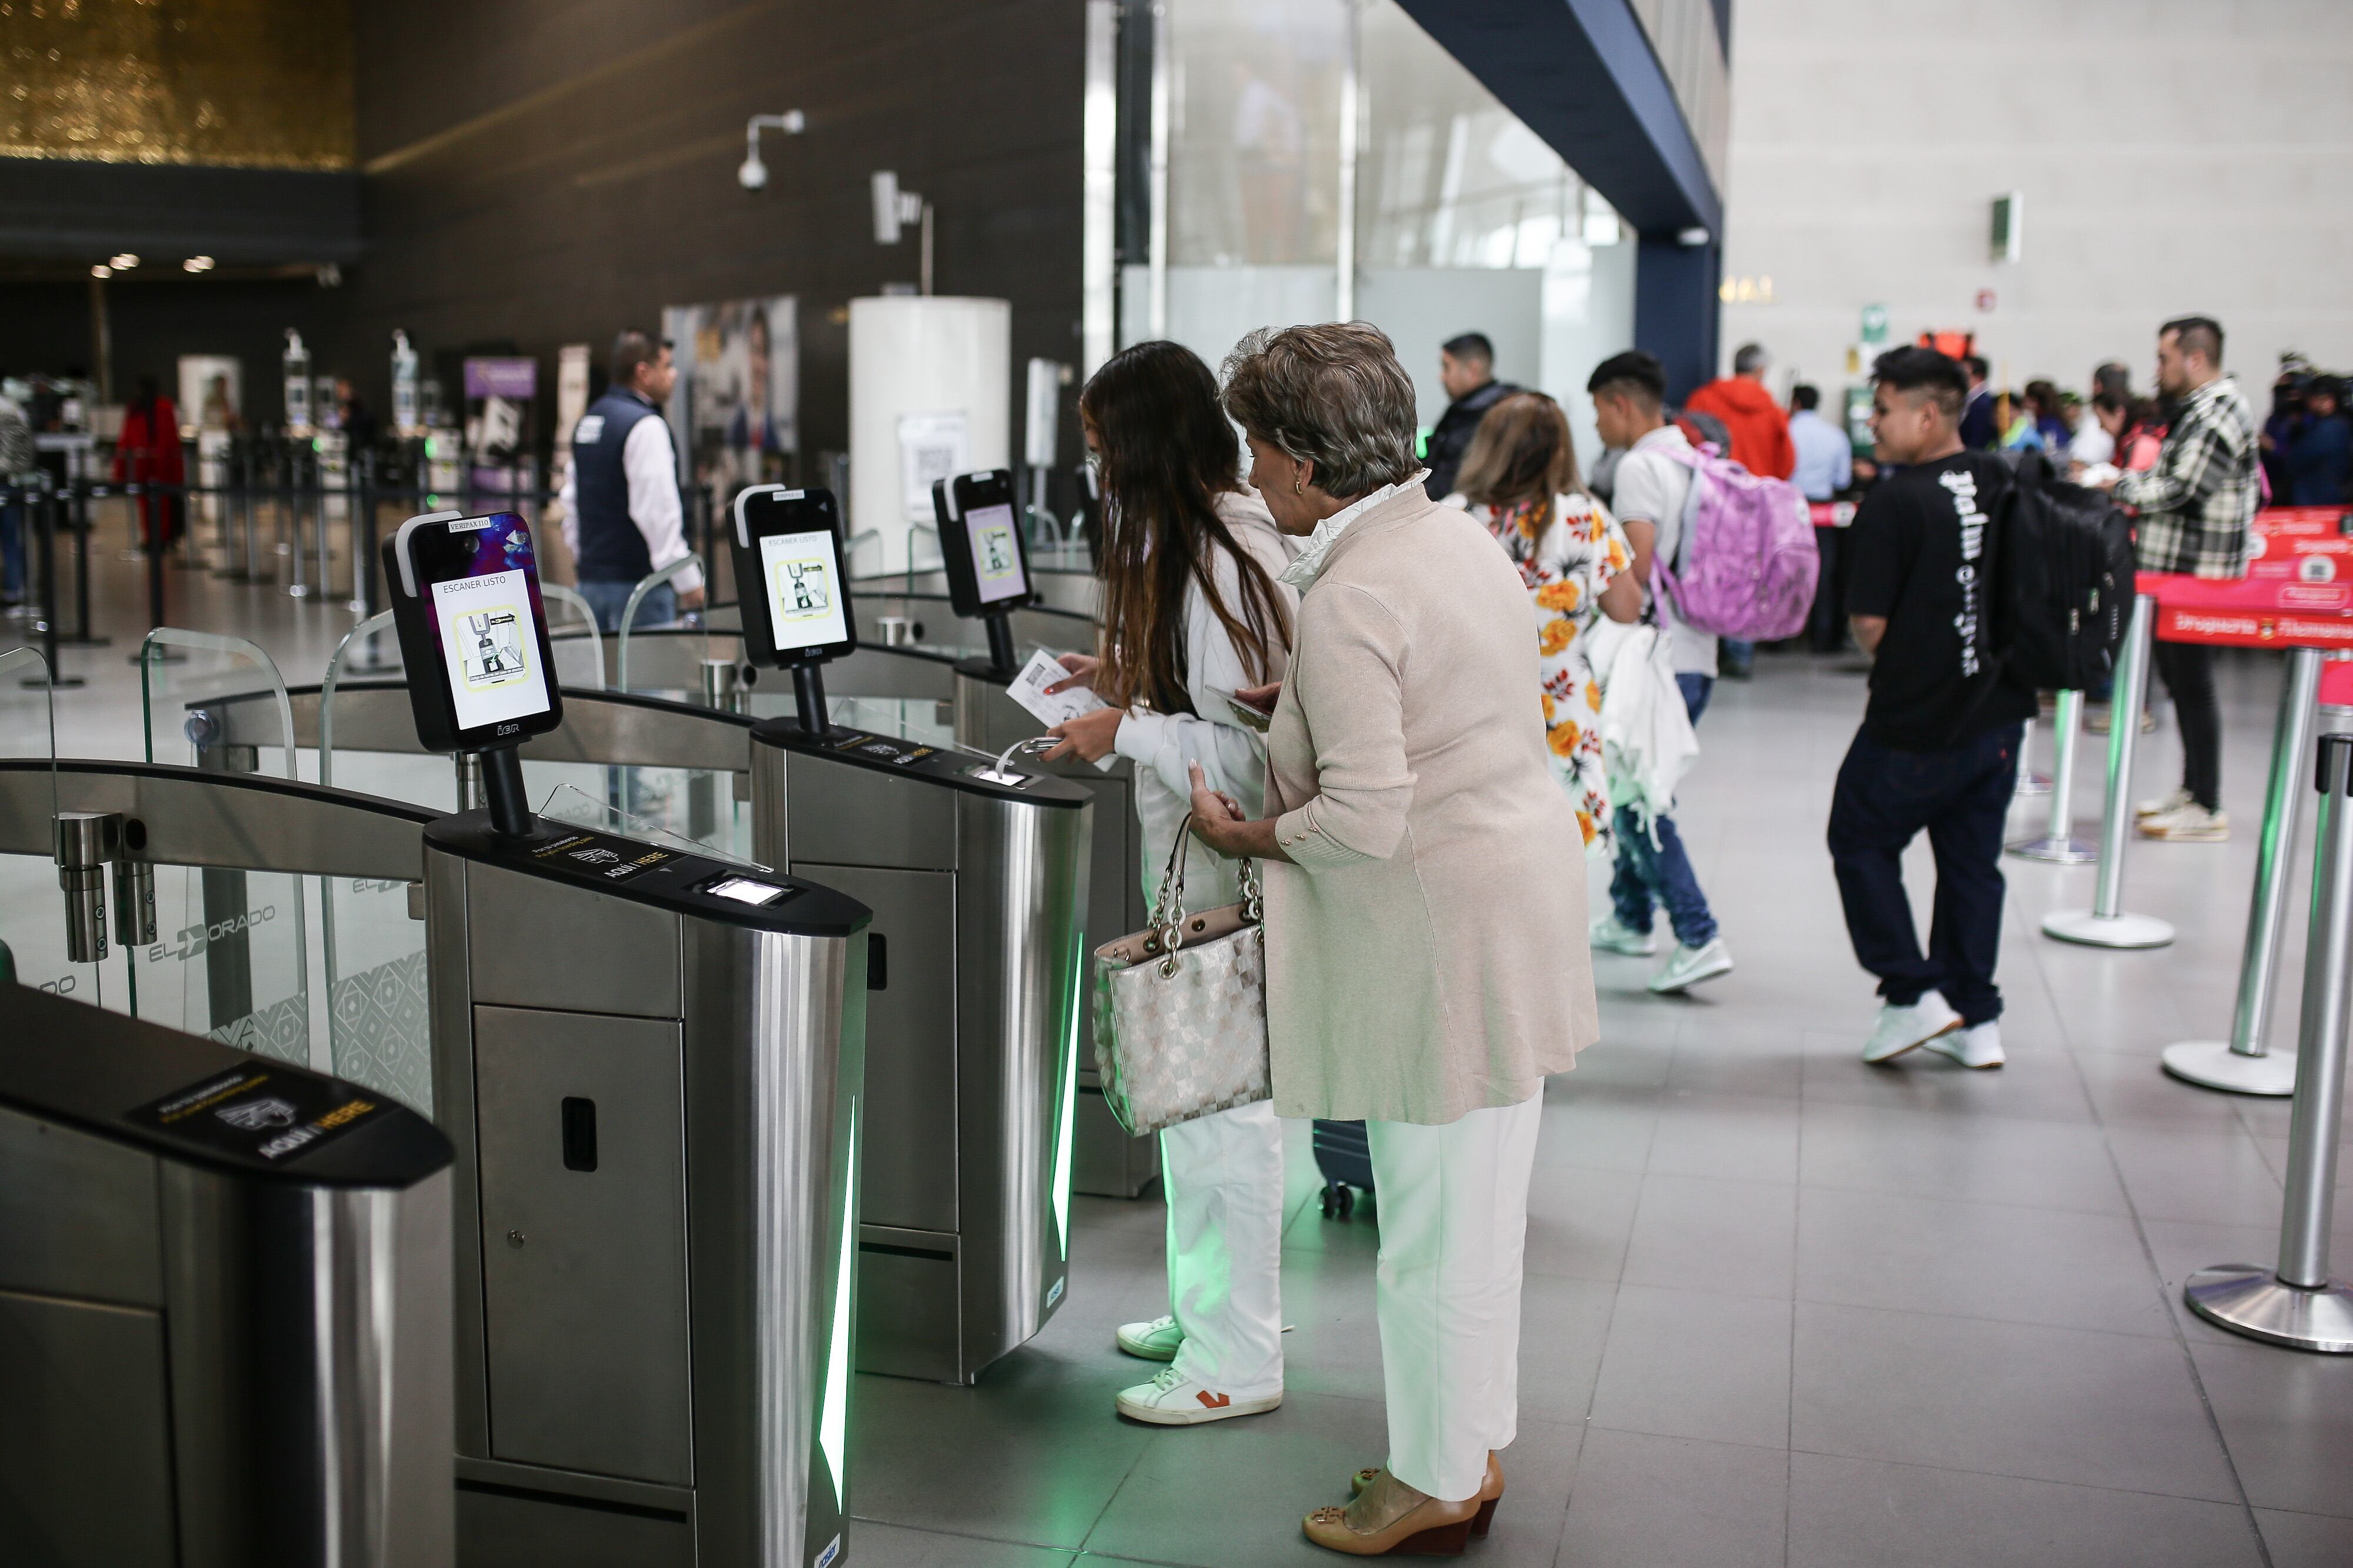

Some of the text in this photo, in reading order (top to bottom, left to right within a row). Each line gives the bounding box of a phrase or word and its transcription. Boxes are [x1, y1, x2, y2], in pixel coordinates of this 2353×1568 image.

[450, 521, 478, 530] VERIPAX
[444, 576, 506, 593] ESCANER LISTO
[604, 863, 636, 878] AQUÍ
[634, 852, 669, 865] HERE
